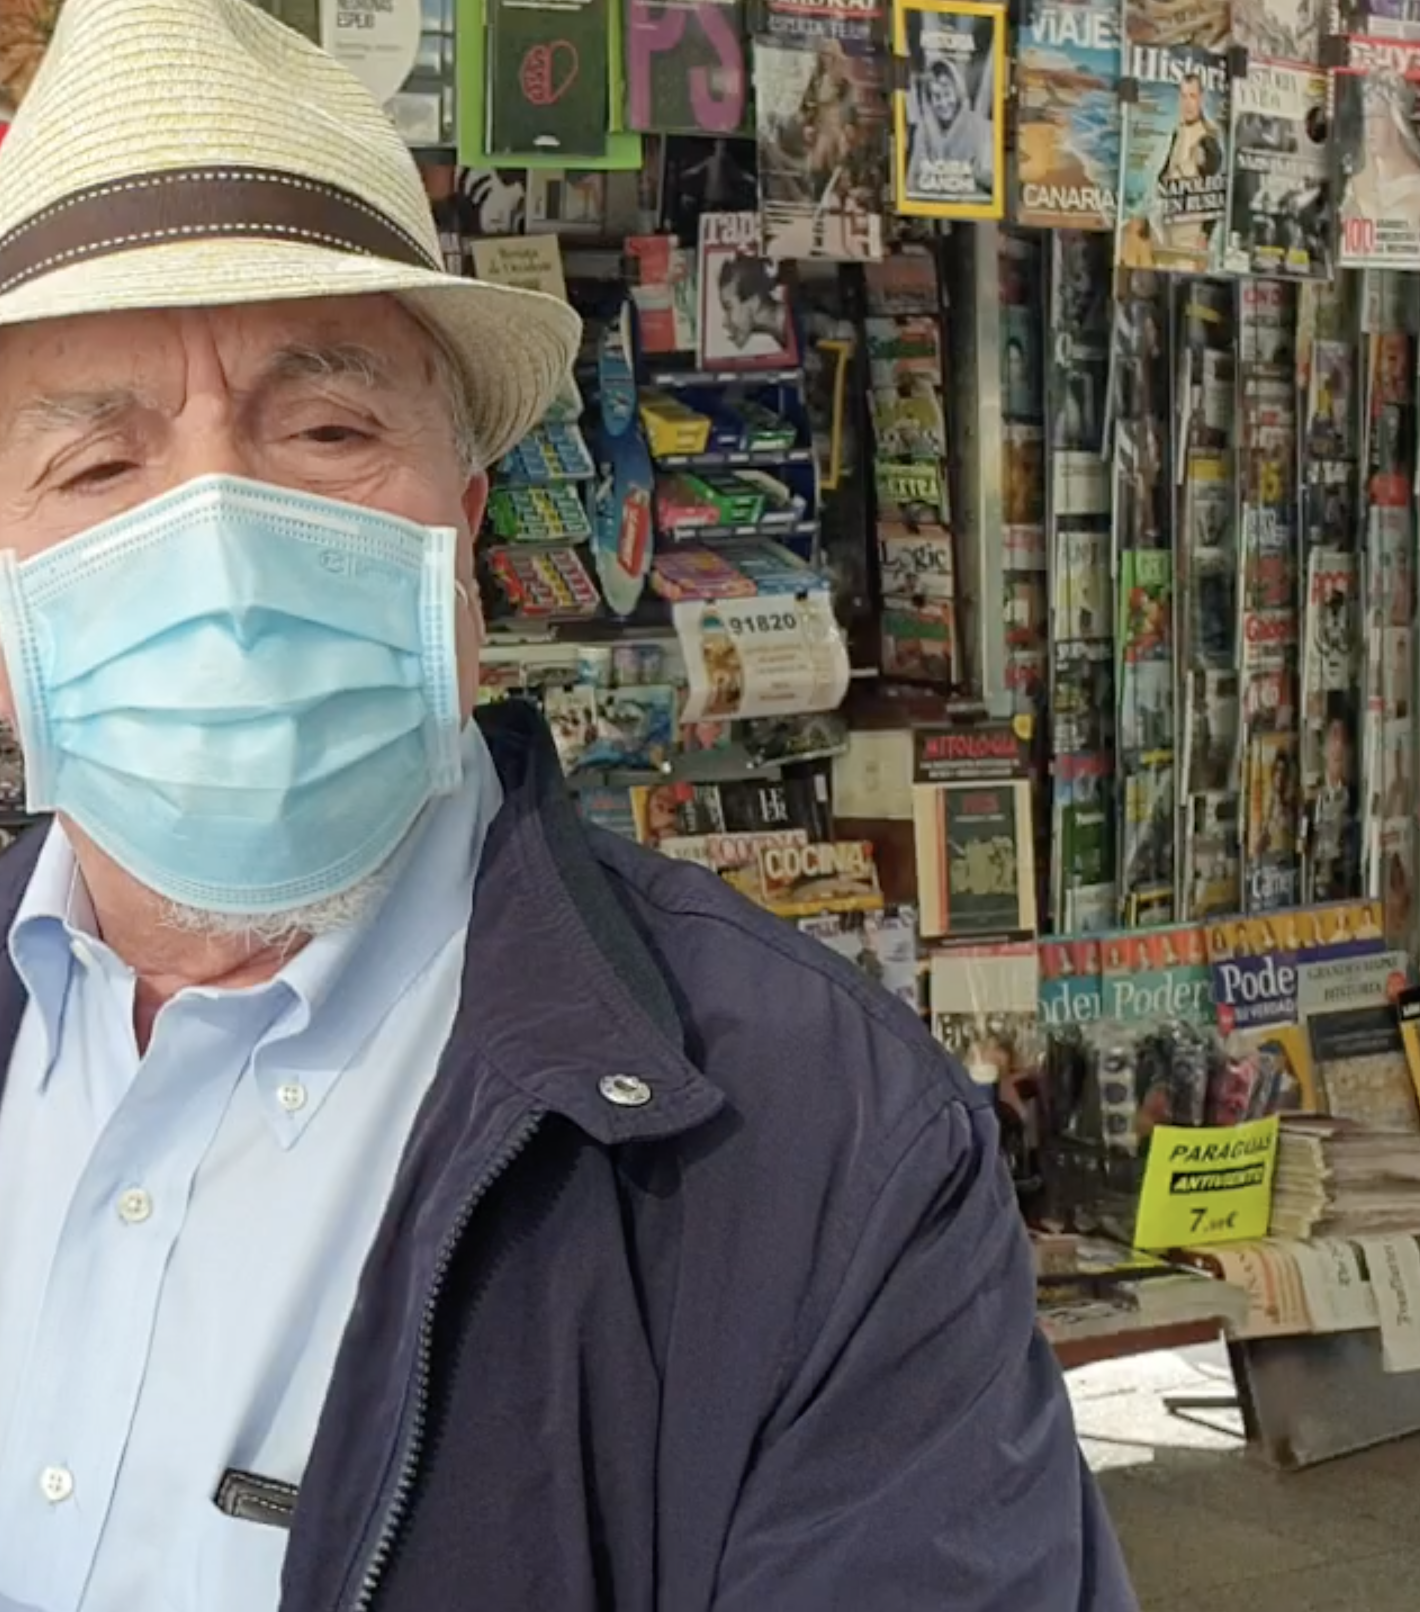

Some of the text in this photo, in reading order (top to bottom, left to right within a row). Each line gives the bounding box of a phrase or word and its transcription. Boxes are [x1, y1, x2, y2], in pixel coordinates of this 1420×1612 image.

[1031, 9, 1120, 49] VIAJE
[1022, 182, 1120, 213] CANARIA
[1343, 218, 1374, 253] 100
[730, 612, 797, 635] 91820
[765, 845, 865, 880] COCINA
[1112, 970, 1209, 1021] Poder
